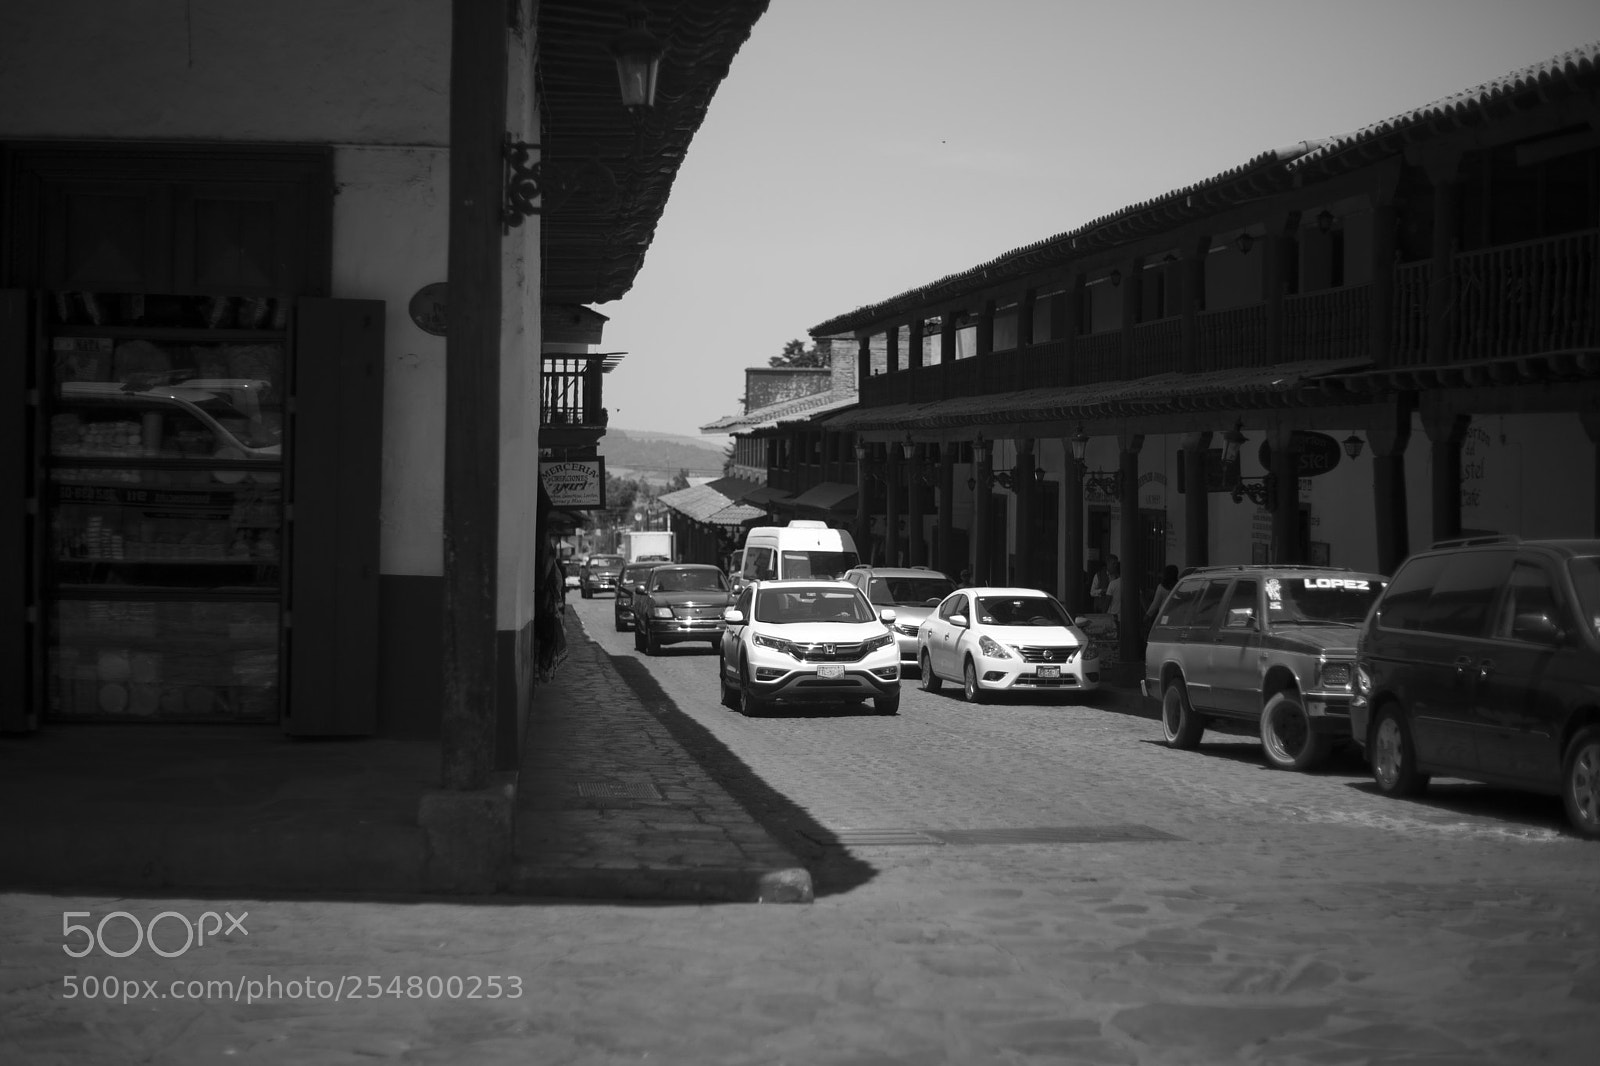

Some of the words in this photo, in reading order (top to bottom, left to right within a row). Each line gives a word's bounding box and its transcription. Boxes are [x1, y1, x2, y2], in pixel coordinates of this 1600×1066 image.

[1298, 452, 1329, 469] stel
[1464, 456, 1485, 480] stel
[541, 463, 597, 480] MERCERIA
[1304, 579, 1370, 591] LOPEZ
